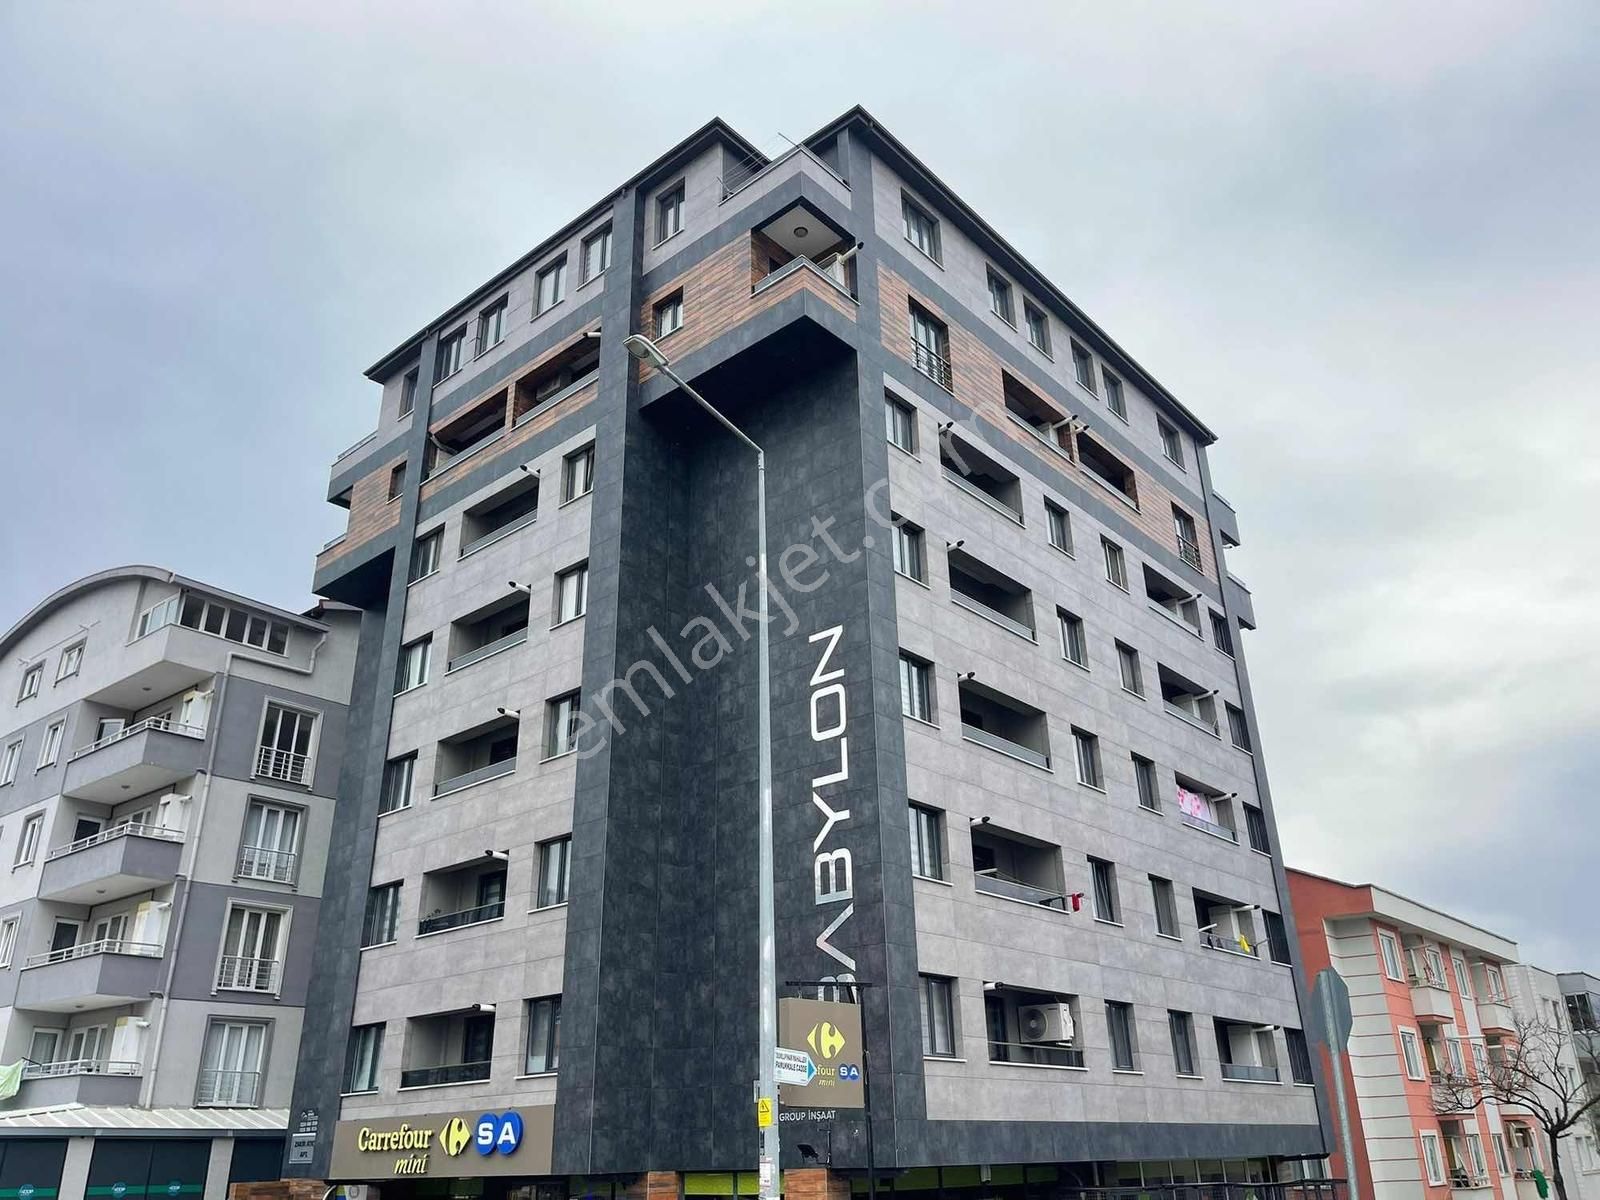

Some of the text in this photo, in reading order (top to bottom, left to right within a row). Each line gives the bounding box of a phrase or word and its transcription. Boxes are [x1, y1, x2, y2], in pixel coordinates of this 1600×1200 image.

[840, 1067, 859, 1077] SA
[818, 1079, 835, 1087] mini
[779, 1112, 806, 1122] GROUP
[808, 1110, 836, 1123] İNŞAAT
[358, 1120, 516, 1152] Carrefour SA
[394, 1154, 428, 1175] mini
